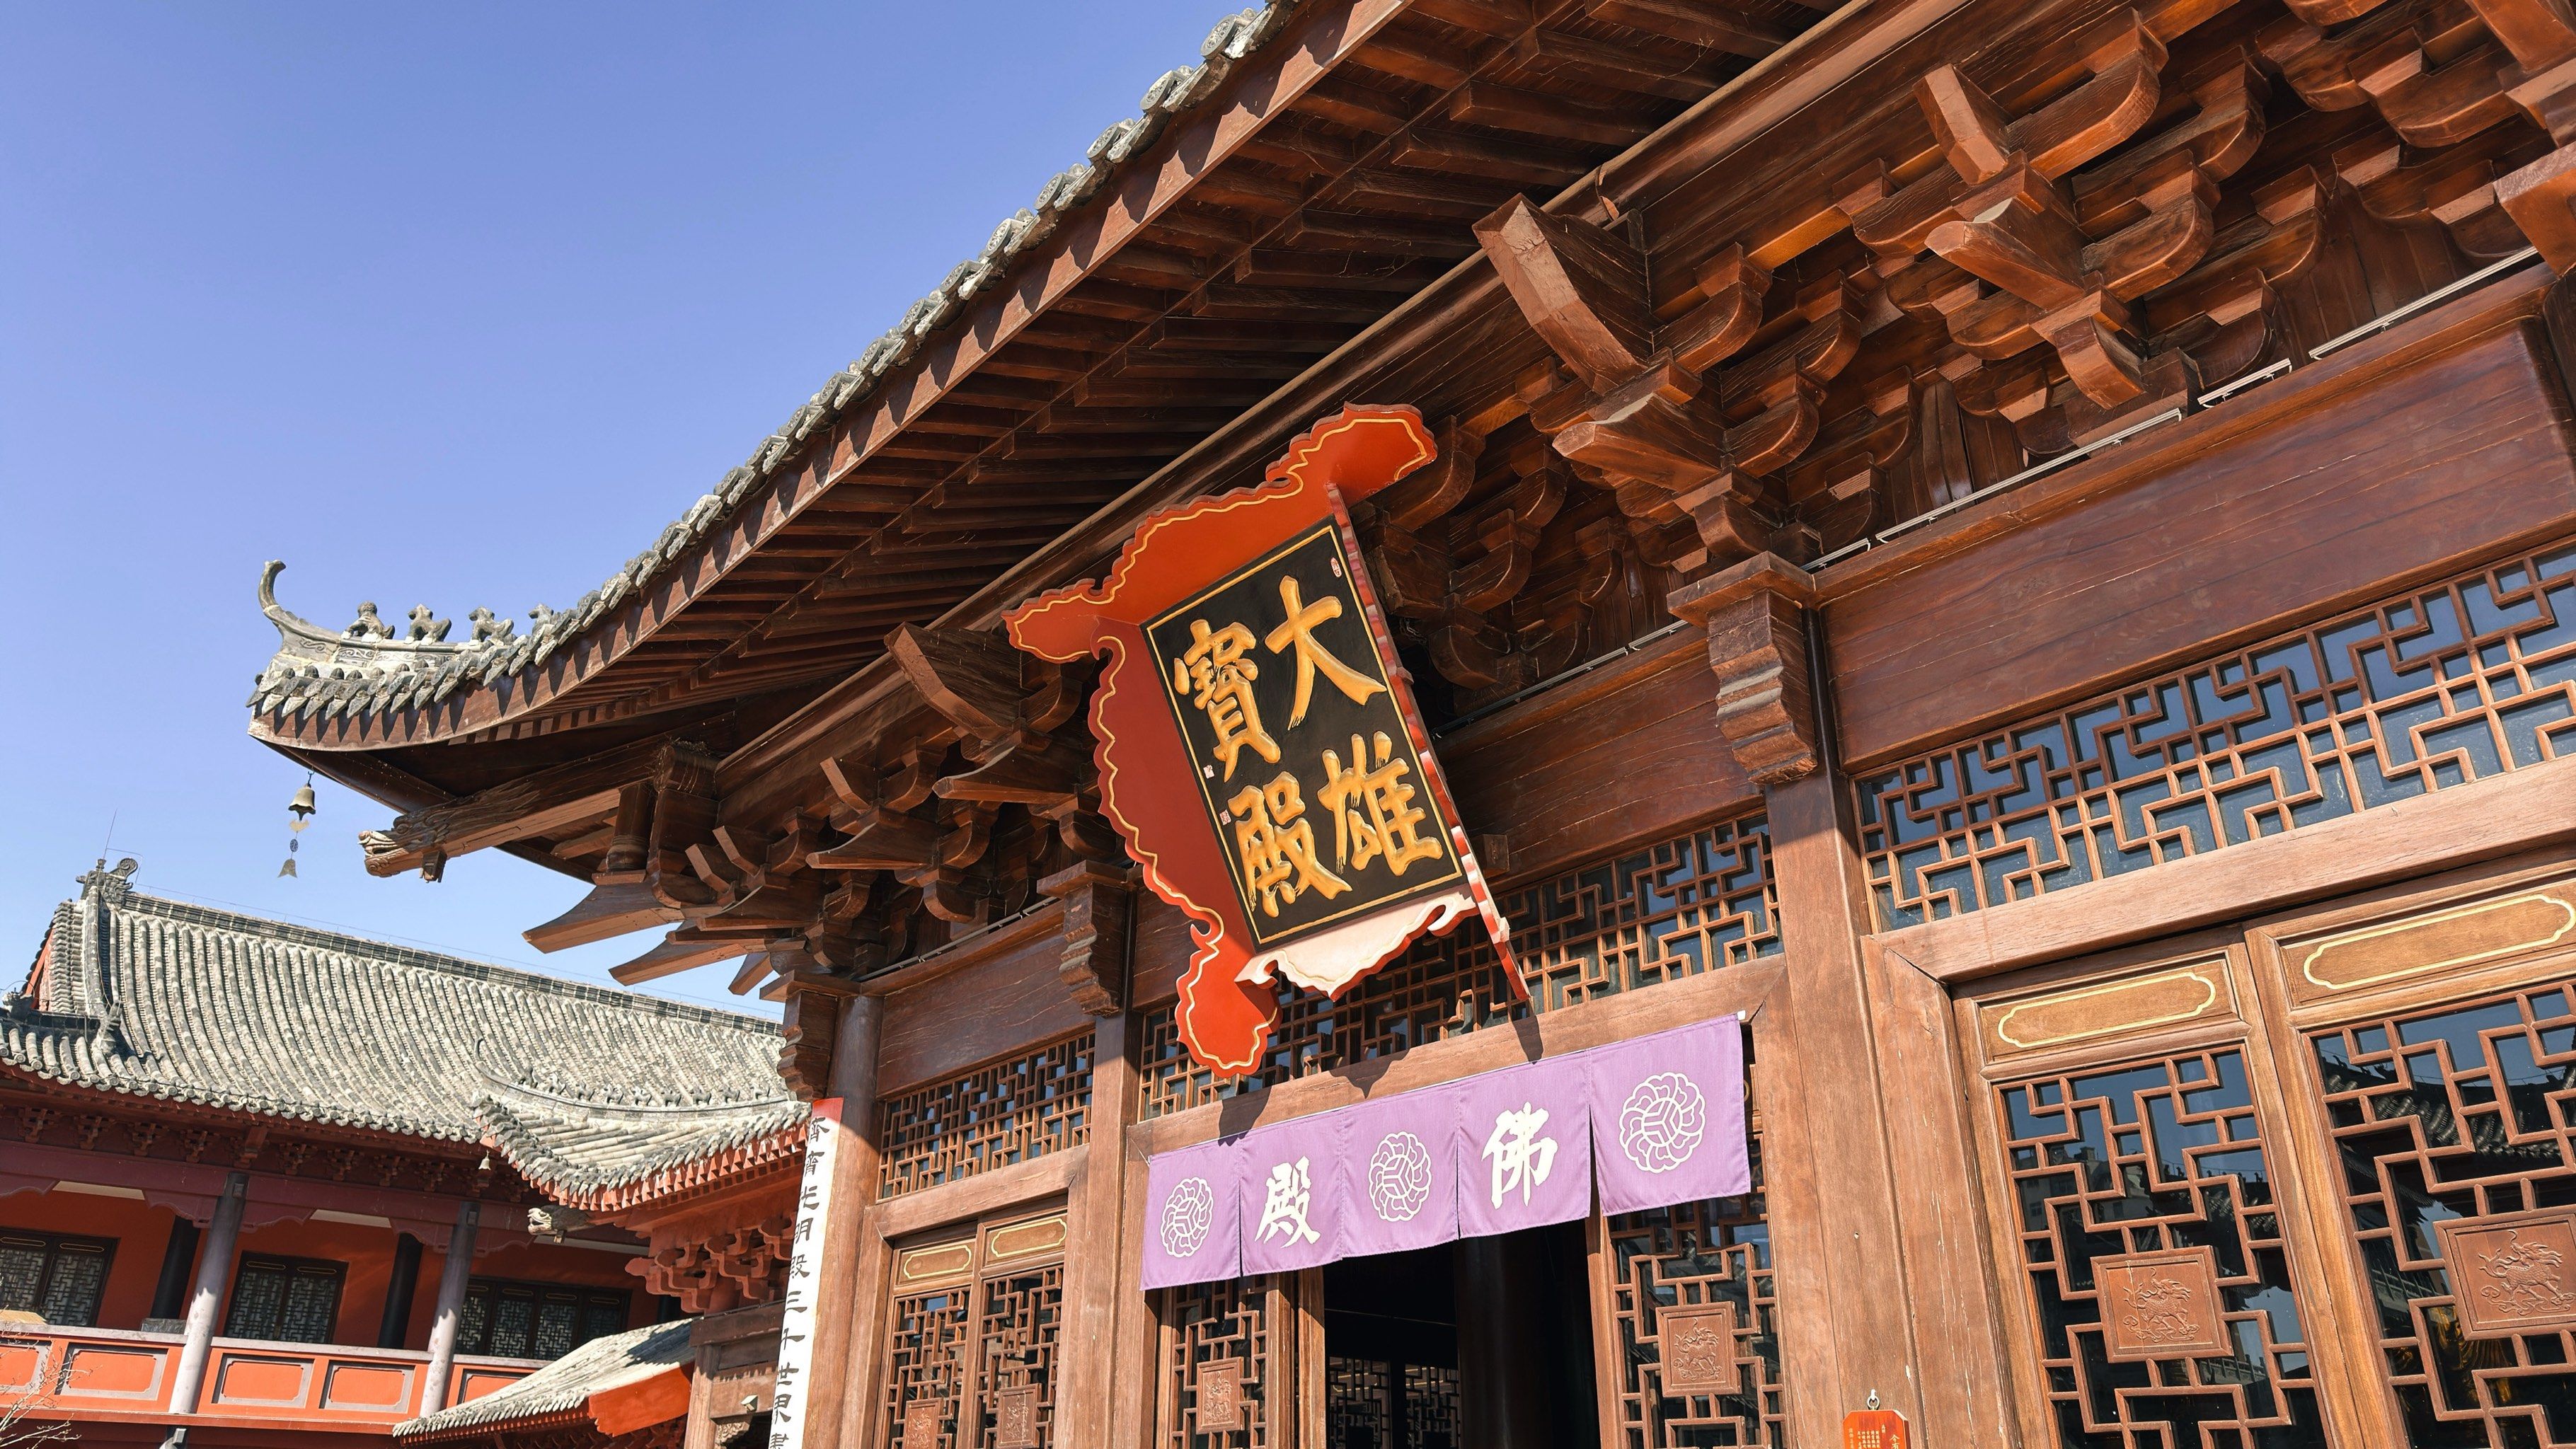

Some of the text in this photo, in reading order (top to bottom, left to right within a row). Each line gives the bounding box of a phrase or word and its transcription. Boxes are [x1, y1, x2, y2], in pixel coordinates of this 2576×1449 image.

[1265, 575, 1442, 877] 大雄
[1254, 1102, 1558, 1248] 佛 殿
